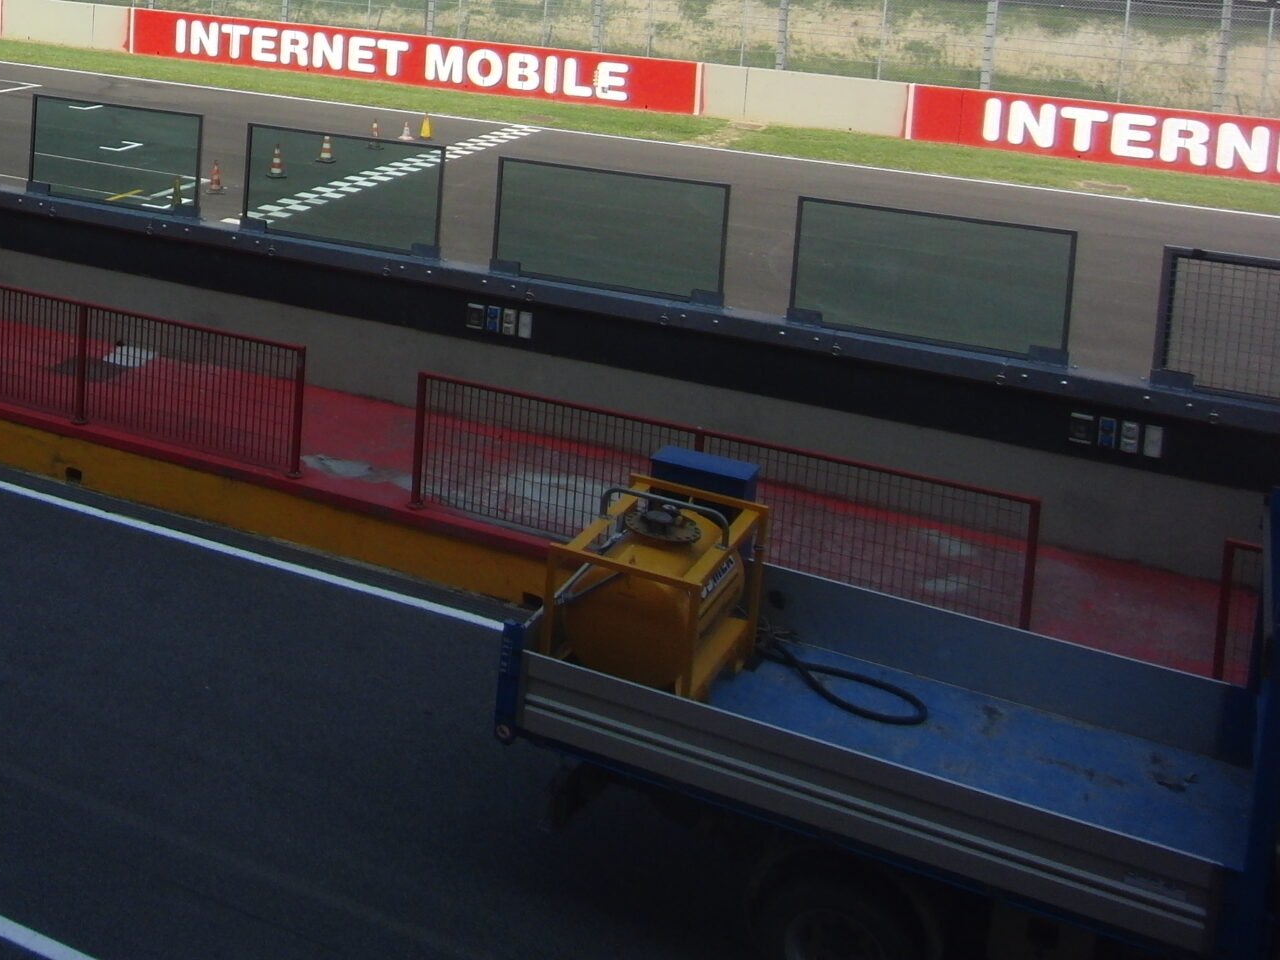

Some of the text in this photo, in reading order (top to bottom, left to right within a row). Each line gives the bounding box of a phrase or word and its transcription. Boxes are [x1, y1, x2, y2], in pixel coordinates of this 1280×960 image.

[175, 18, 629, 102] INTERNET MOBILE
[982, 97, 1280, 173] INTERN
